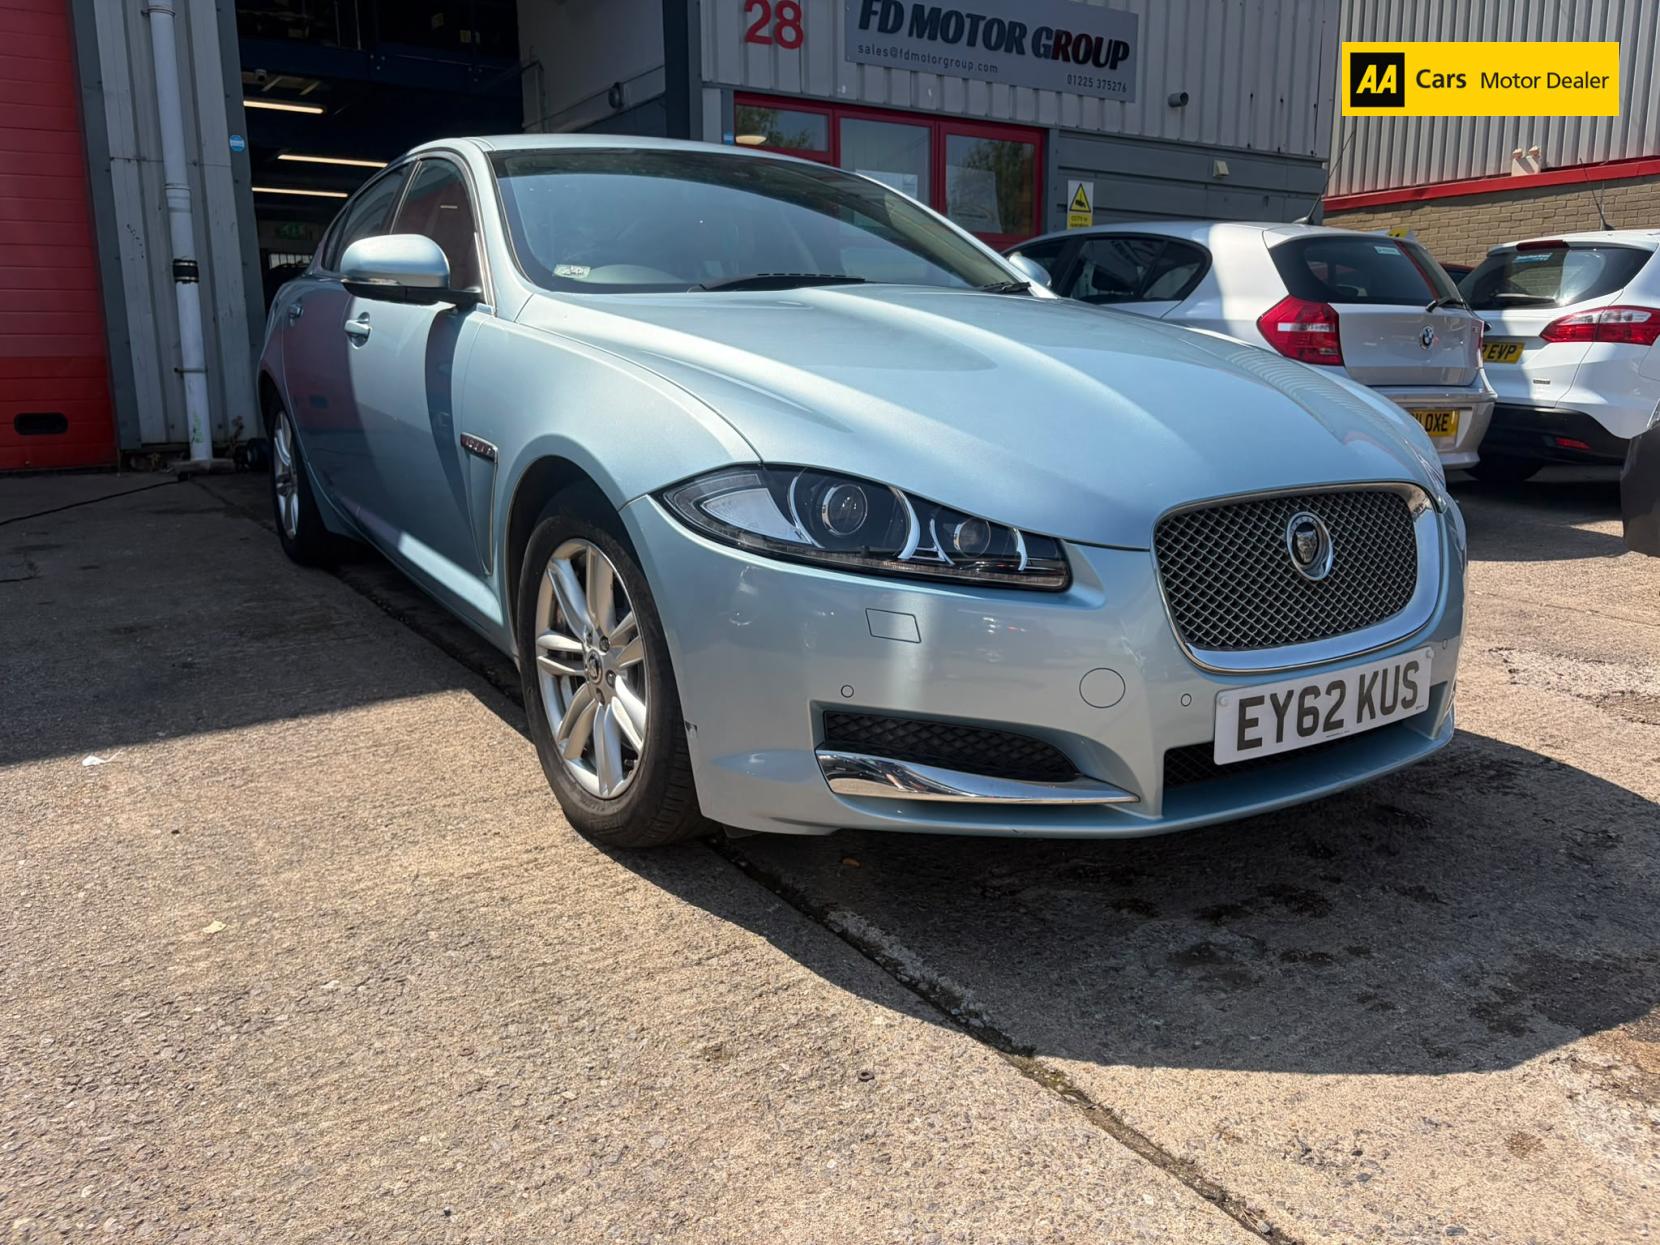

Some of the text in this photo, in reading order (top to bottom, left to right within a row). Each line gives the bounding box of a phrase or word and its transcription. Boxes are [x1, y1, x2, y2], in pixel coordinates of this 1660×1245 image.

[743, 0, 804, 49] 28
[858, 0, 1131, 71] FD MOTOR GROUP
[857, 43, 999, 73] sales@fdmotorgroup.com
[1066, 74, 1128, 94] 01225 375276
[1237, 660, 1419, 751] EY62 KUS
